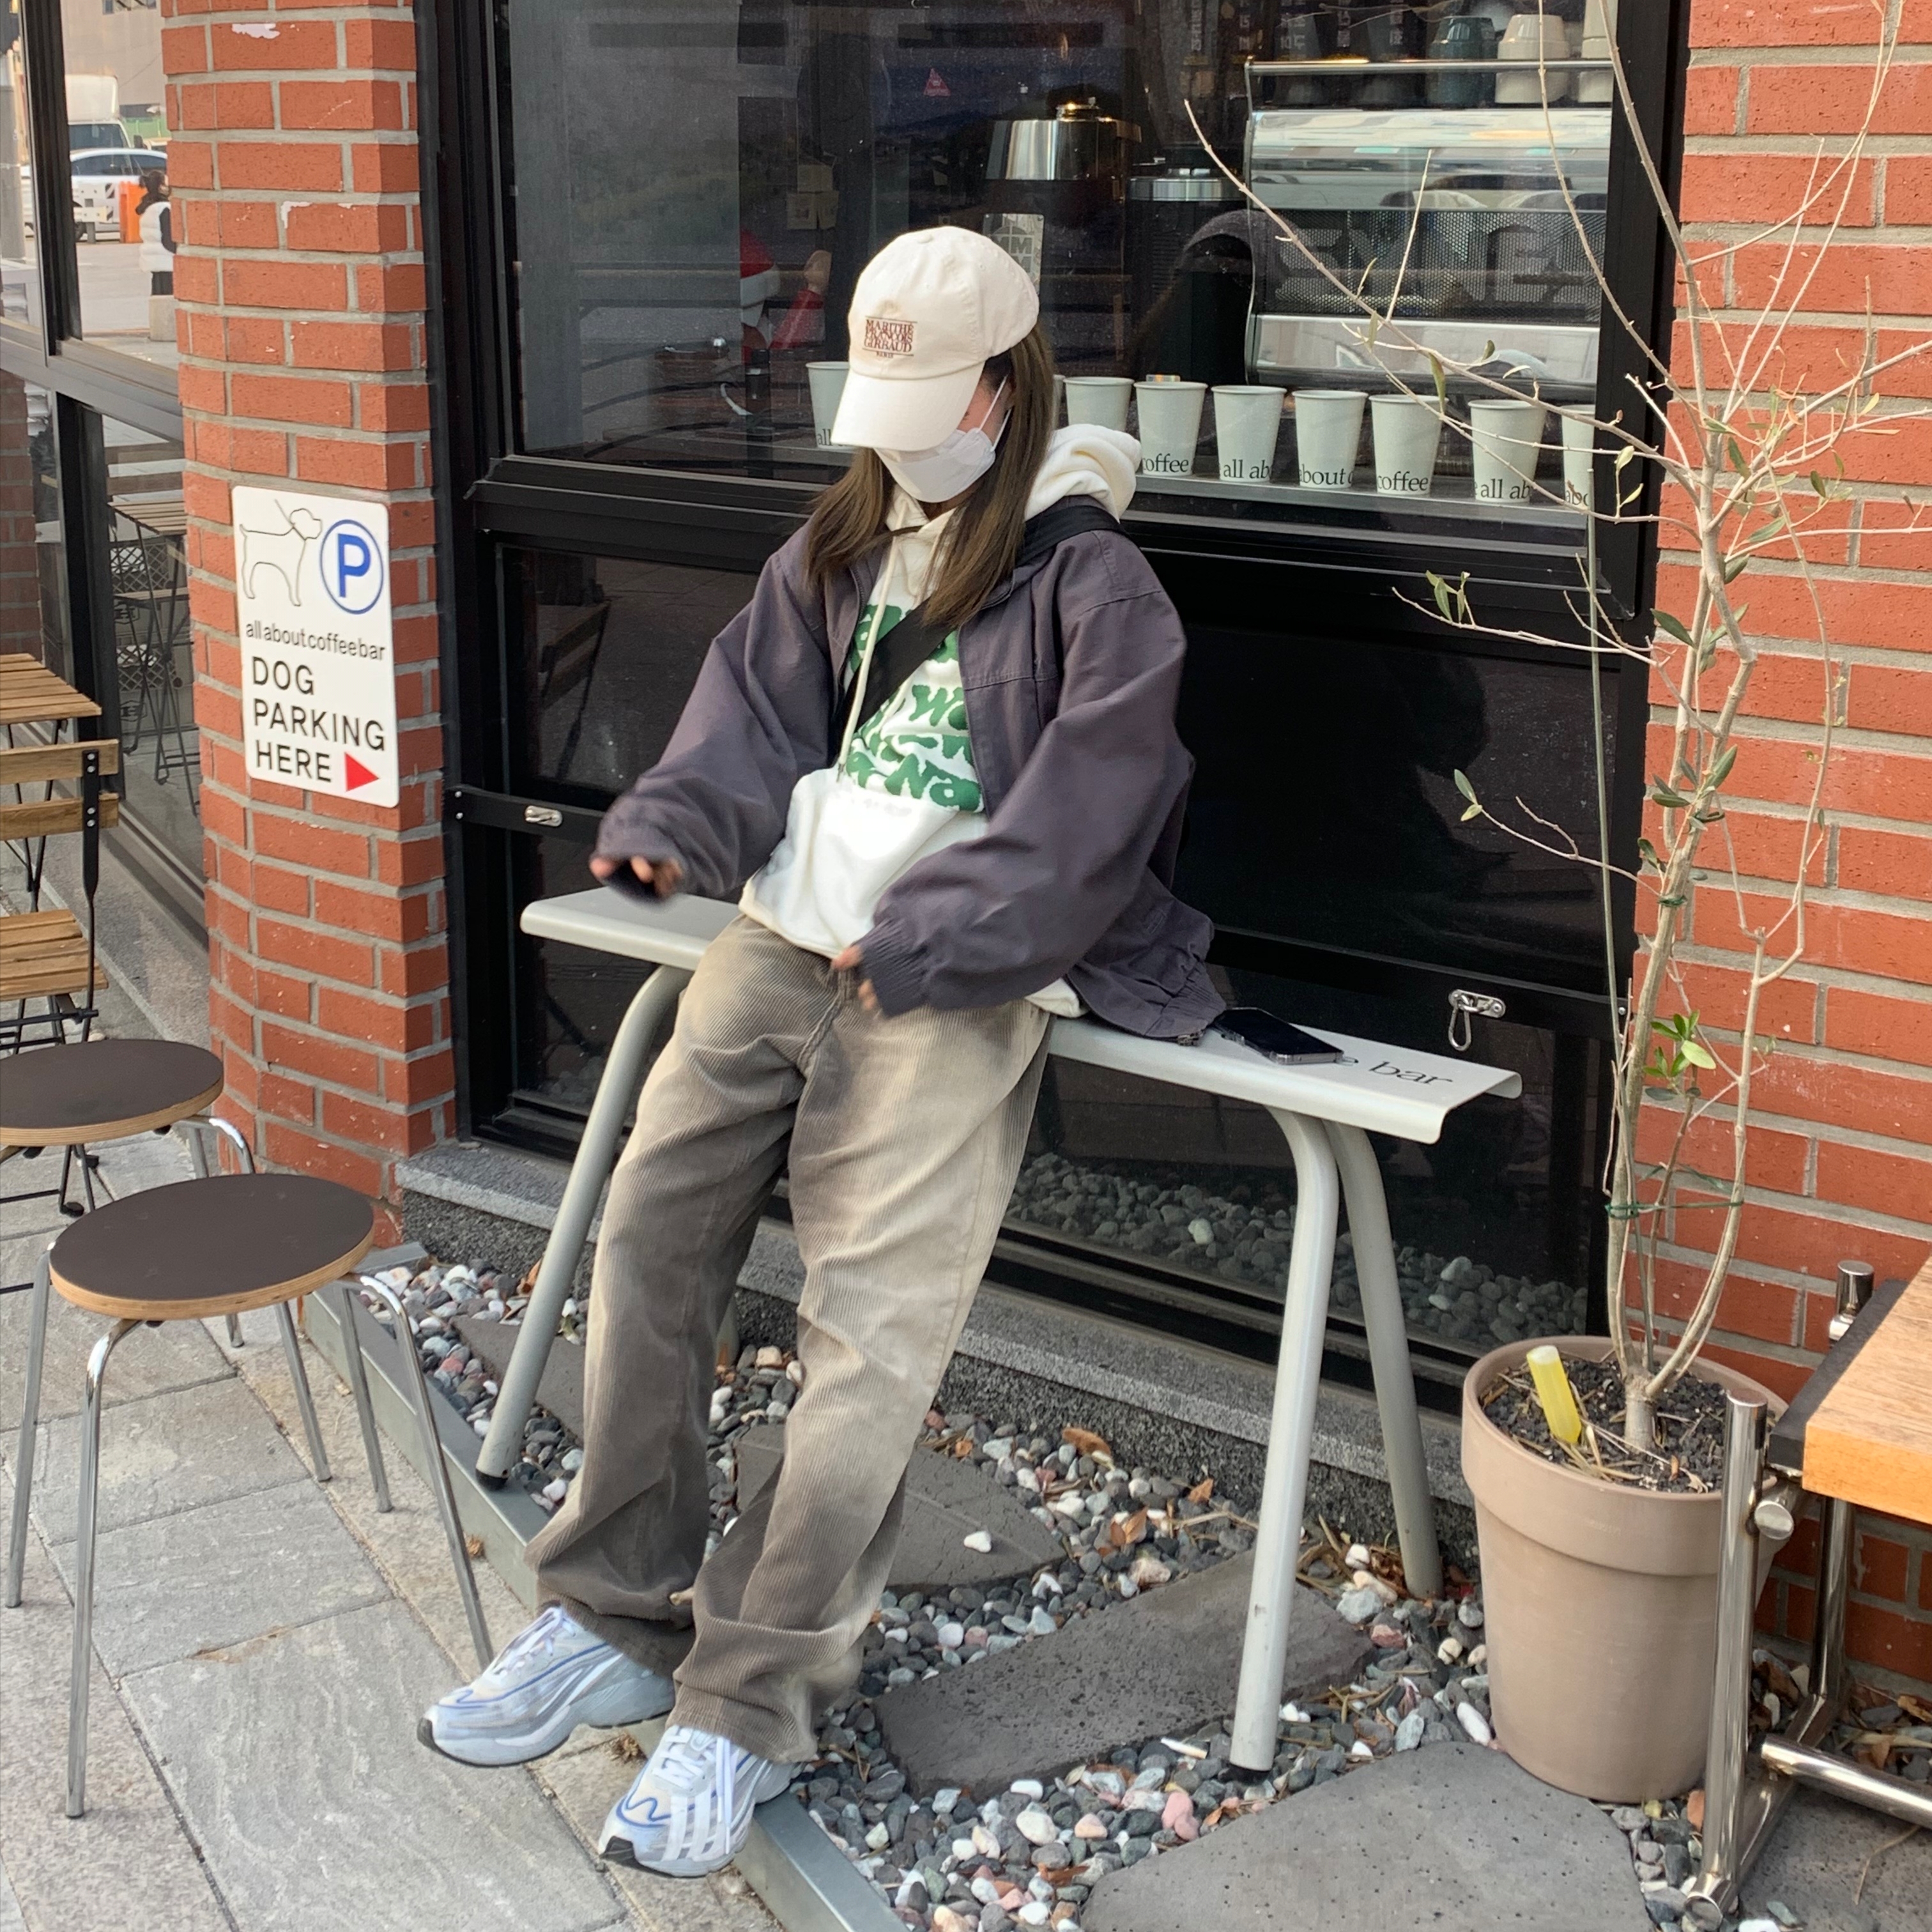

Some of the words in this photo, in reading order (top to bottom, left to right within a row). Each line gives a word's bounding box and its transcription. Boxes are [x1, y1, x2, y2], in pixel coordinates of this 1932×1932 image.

[1223, 459, 1244, 479] all
[1480, 478, 1503, 499] all
[337, 533, 371, 598] P
[252, 656, 314, 695] DOG
[254, 698, 385, 751] PARKING
[256, 739, 332, 783] HERE
[1368, 1061, 1453, 1085] bar
